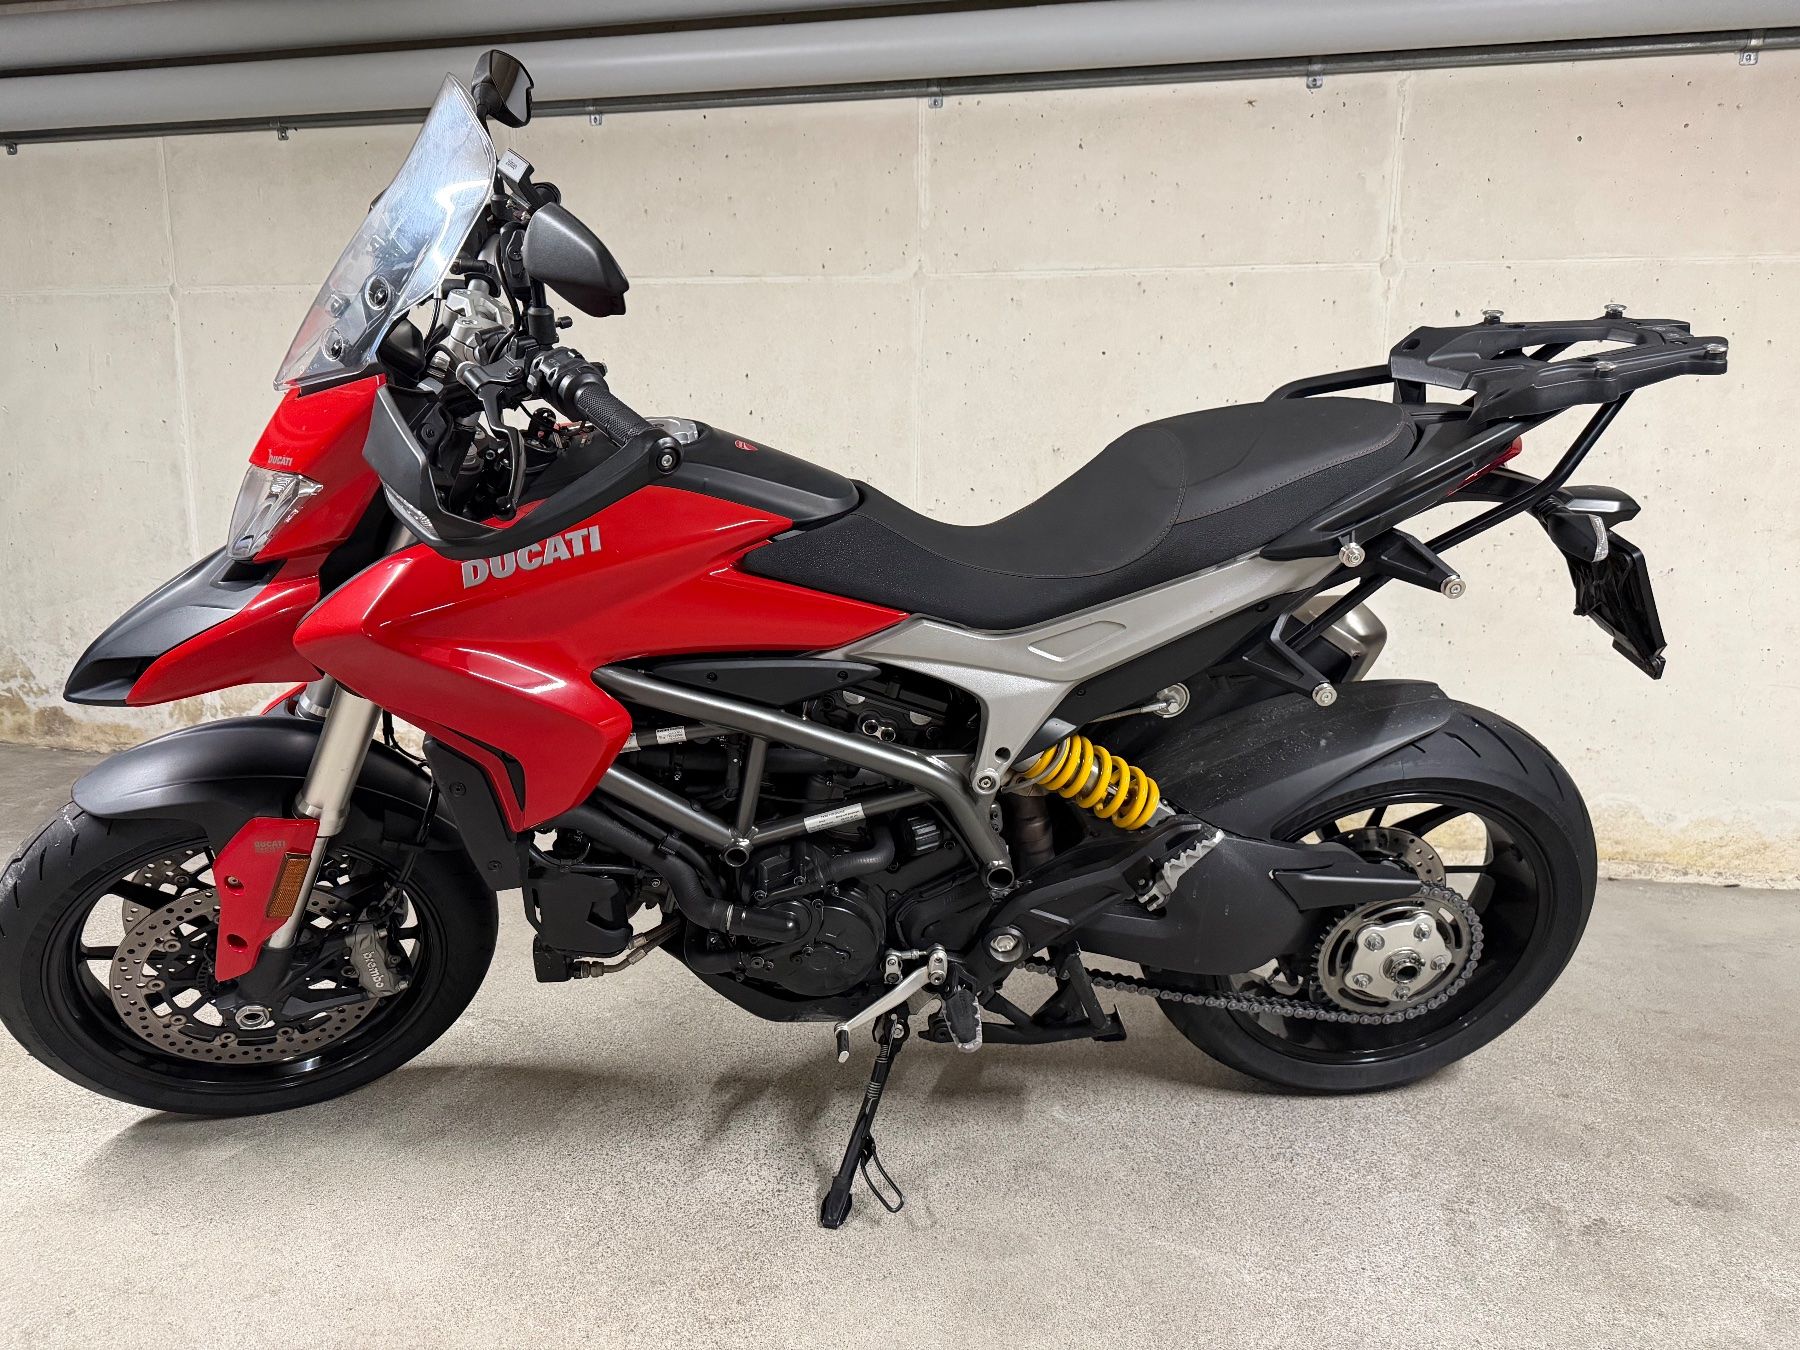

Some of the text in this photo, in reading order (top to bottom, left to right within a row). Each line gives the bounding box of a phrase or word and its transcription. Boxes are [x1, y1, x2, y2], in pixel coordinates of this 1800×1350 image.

[268, 448, 293, 467] DUCATI
[461, 525, 601, 589] DUCATI
[362, 951, 385, 988] brembo
